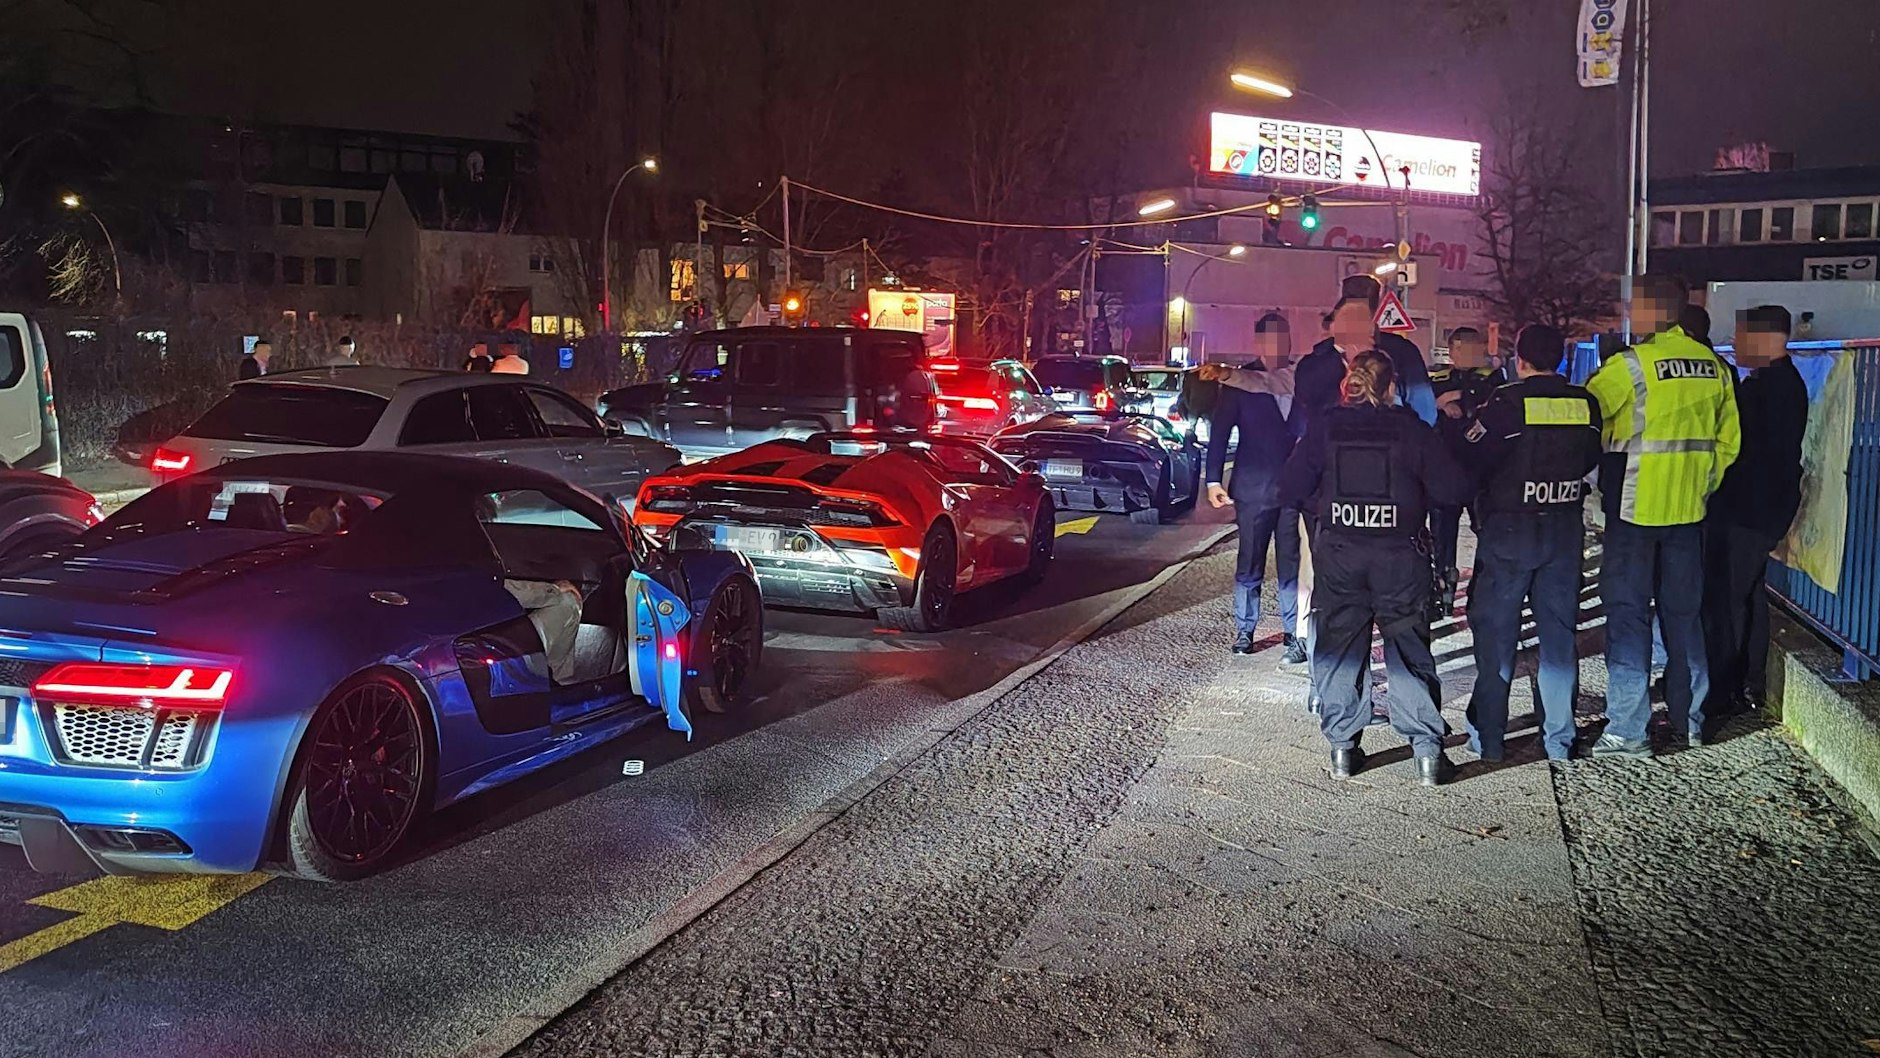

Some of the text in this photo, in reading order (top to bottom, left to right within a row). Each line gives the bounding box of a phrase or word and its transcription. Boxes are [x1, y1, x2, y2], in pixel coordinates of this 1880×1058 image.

[1383, 154, 1456, 178] Camelion
[1809, 264, 1849, 280] TSE
[1655, 360, 1718, 379] POLIZEI
[1523, 480, 1581, 503] POLIZEI
[1331, 502, 1397, 528] POLIZEI
